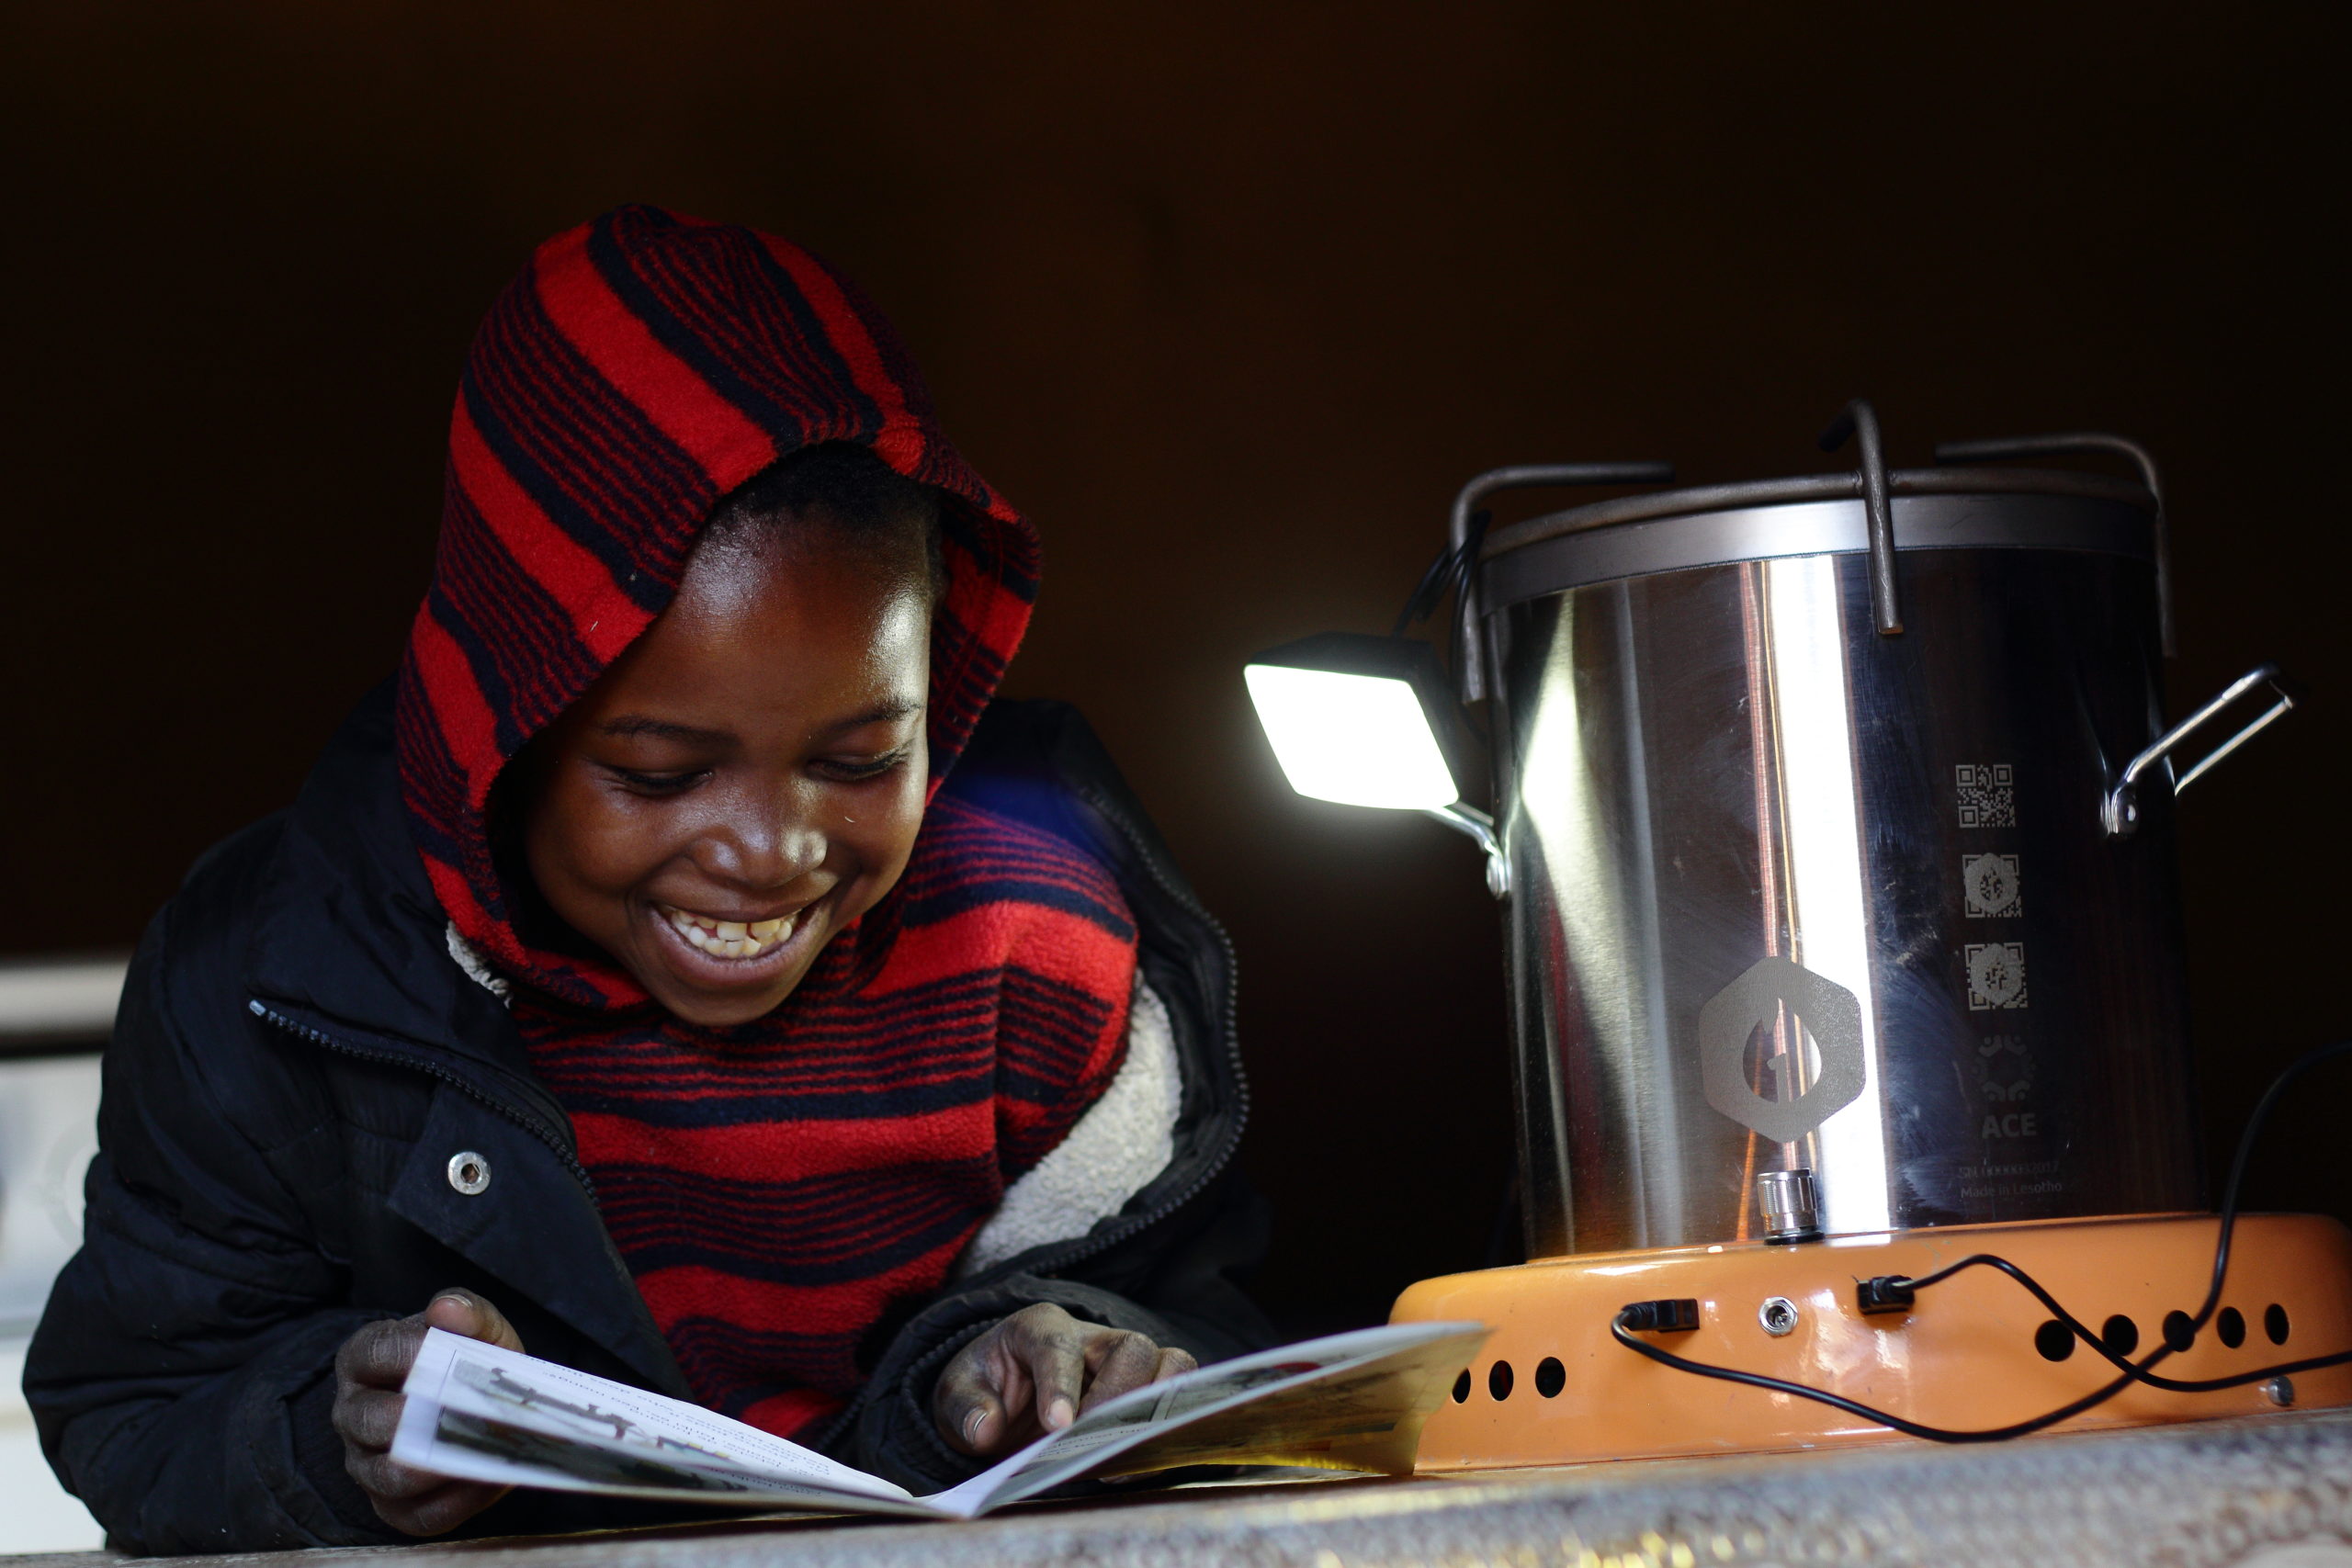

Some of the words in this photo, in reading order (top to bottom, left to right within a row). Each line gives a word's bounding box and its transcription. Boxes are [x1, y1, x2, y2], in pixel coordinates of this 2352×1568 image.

[1982, 1113, 2037, 1139] ACE
[1961, 1184, 1996, 1198] Made
[1998, 1183, 2010, 1196] in
[2013, 1180, 2063, 1193] Lesotho
